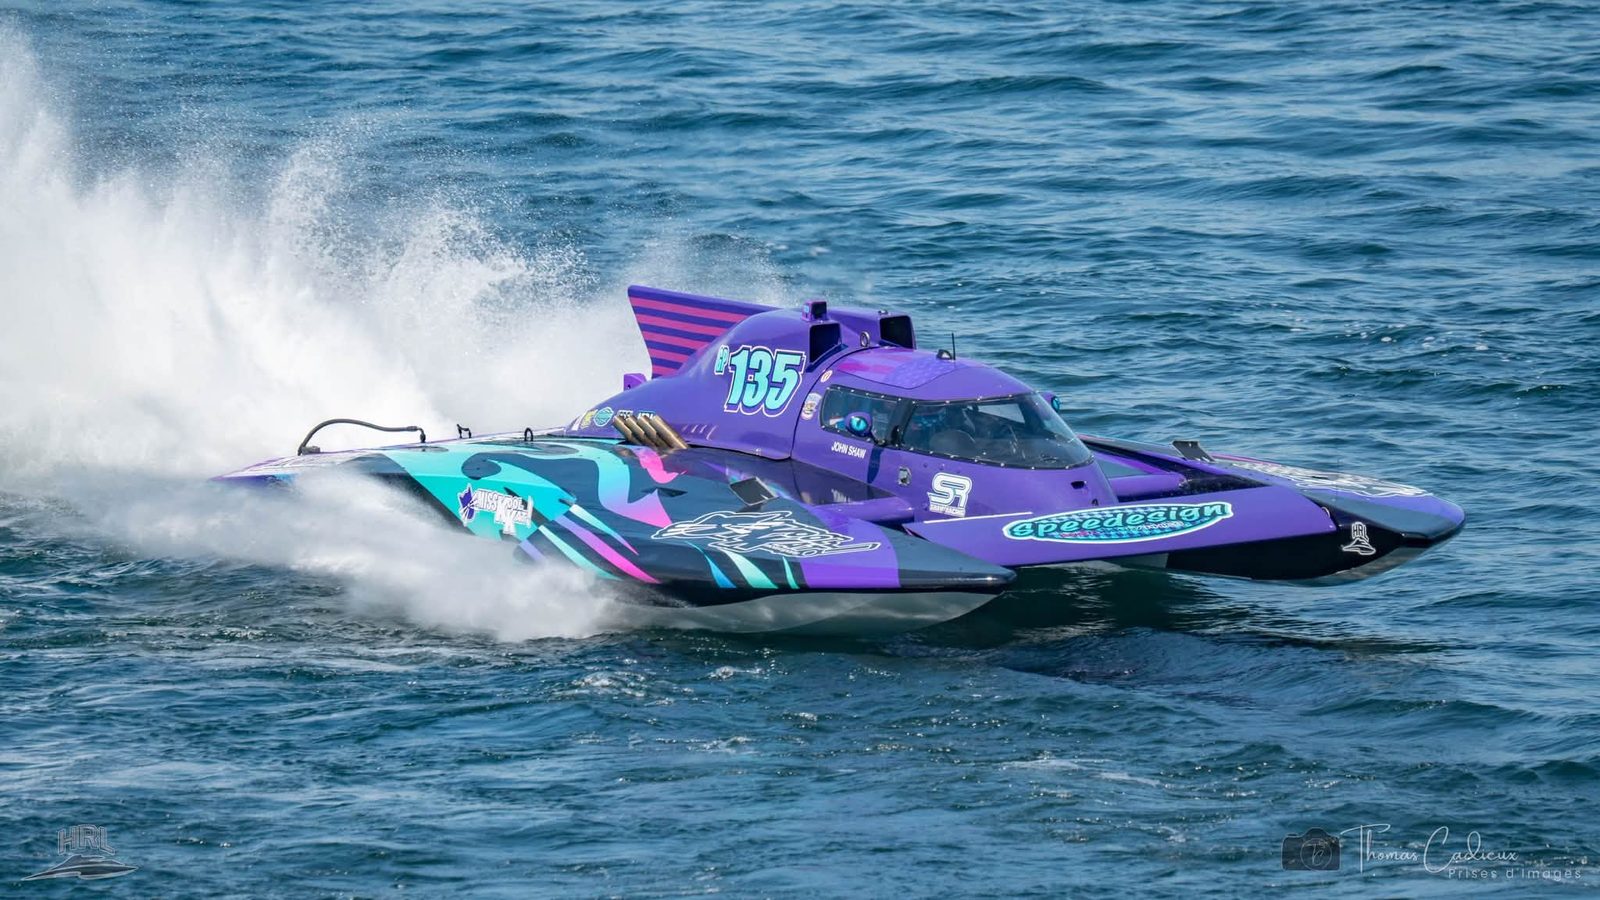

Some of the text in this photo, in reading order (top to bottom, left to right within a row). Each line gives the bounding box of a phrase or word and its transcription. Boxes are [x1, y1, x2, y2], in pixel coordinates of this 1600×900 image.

[724, 345, 806, 417] 135
[831, 441, 867, 459] JOHN SHAW
[1010, 502, 1224, 538] speedesign
[1351, 521, 1370, 543] HRL
